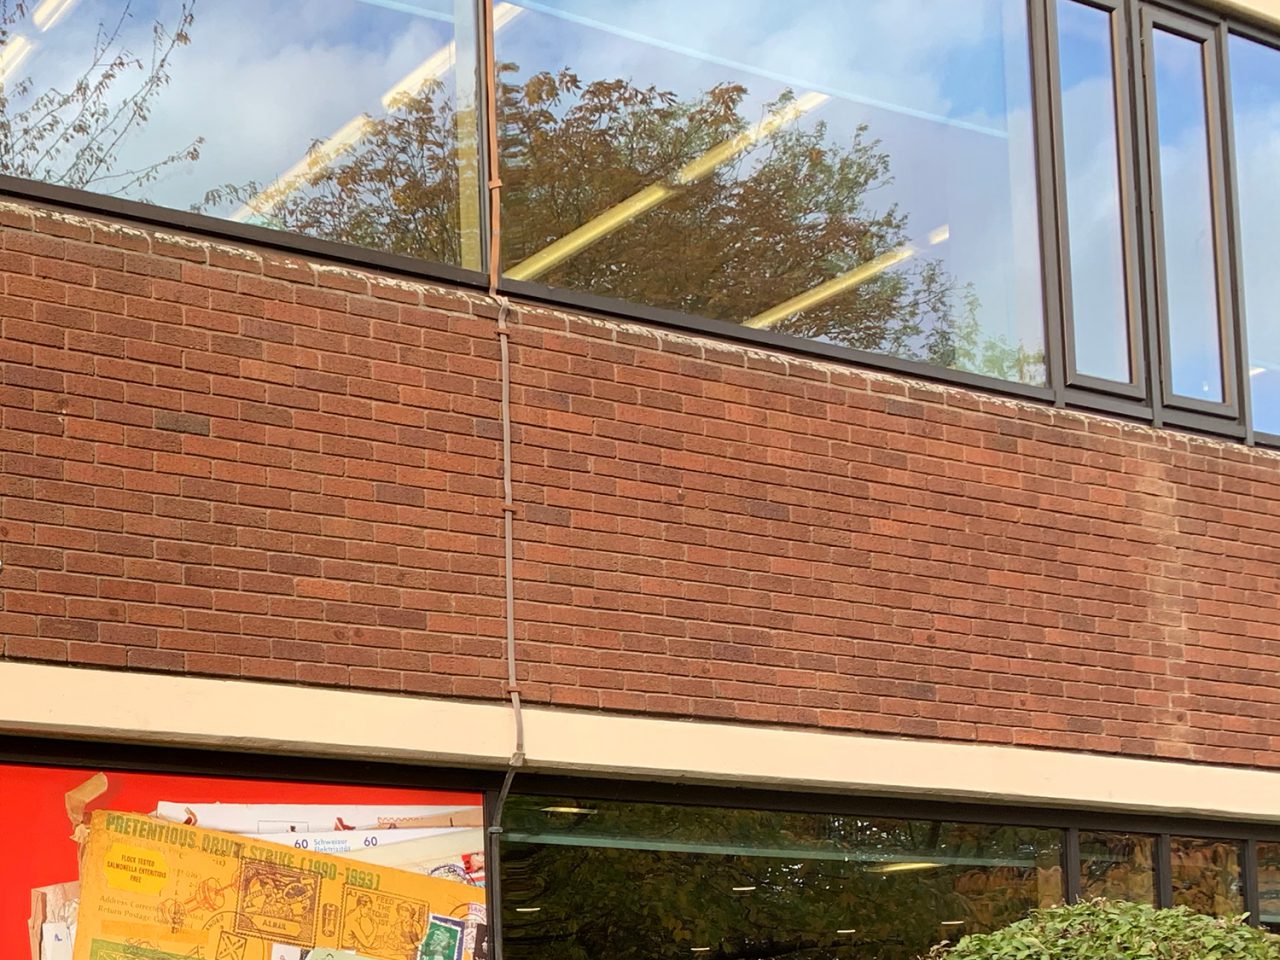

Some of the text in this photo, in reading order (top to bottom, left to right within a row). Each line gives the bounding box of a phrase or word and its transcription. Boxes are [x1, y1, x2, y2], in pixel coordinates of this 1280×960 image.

[105, 813, 197, 849] PRETENTIOUS
[294, 839, 309, 849] 60
[364, 836, 378, 847] 60
